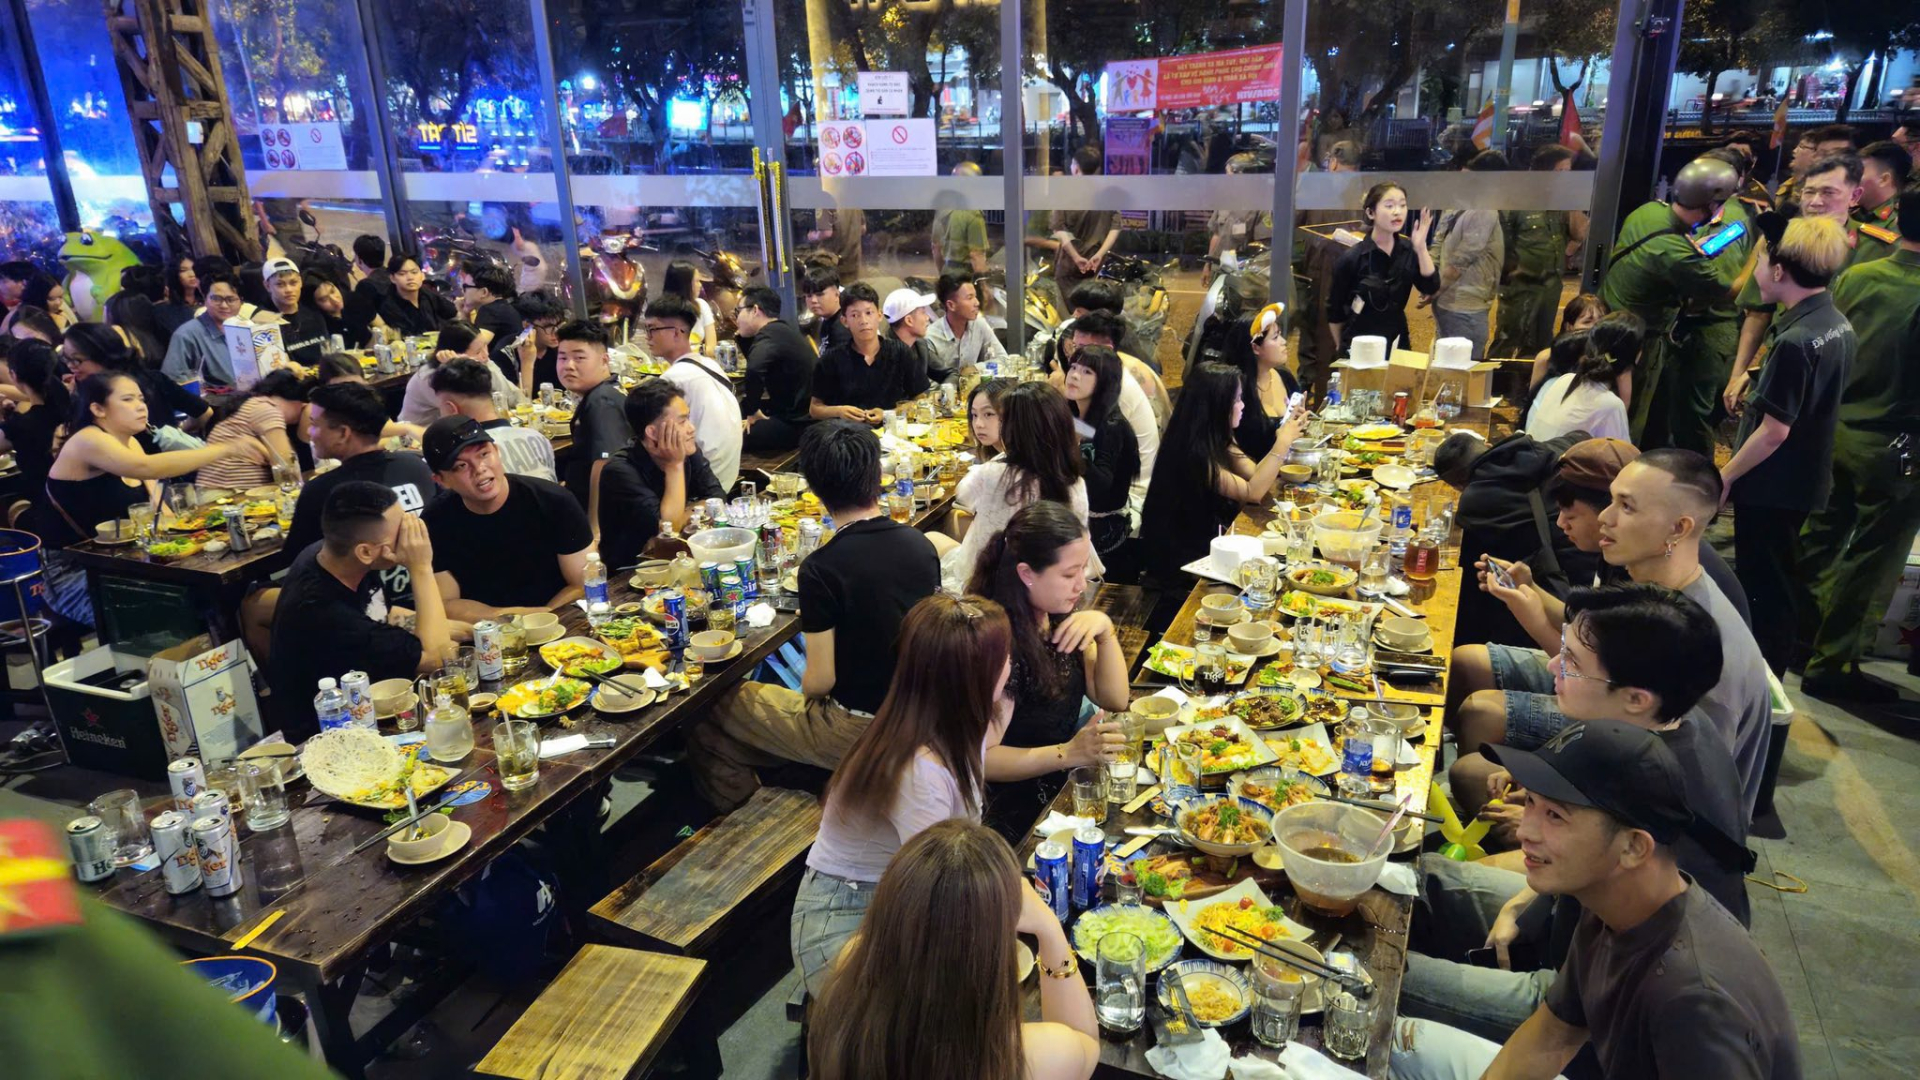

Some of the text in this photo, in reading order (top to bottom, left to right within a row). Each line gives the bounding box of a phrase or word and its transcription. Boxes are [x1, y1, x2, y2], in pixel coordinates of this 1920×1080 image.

[195, 650, 230, 671] Tiger
[211, 694, 237, 716] Tiger
[70, 725, 127, 750] Heineken
